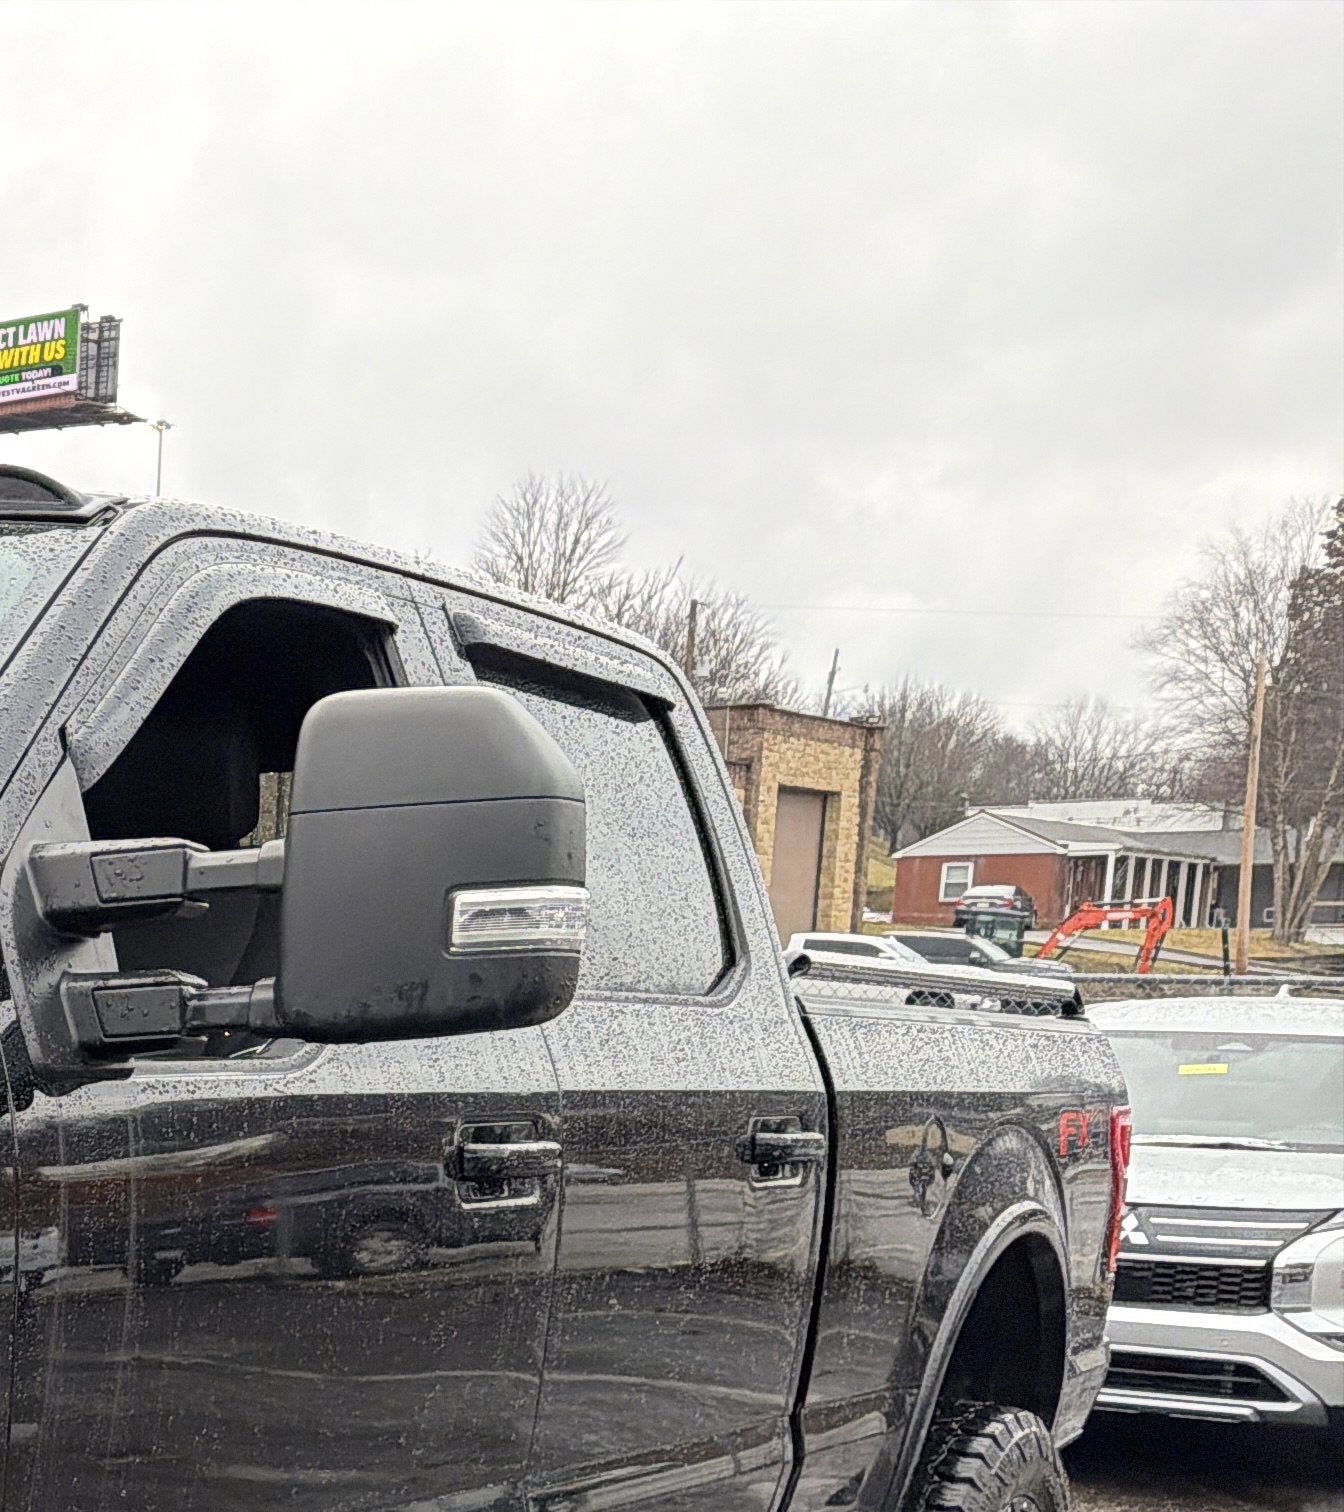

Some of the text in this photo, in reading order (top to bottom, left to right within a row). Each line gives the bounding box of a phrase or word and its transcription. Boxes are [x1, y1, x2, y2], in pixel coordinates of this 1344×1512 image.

[19, 318, 66, 345] LAWN
[43, 339, 66, 361] US
[21, 367, 52, 381] TODAY!
